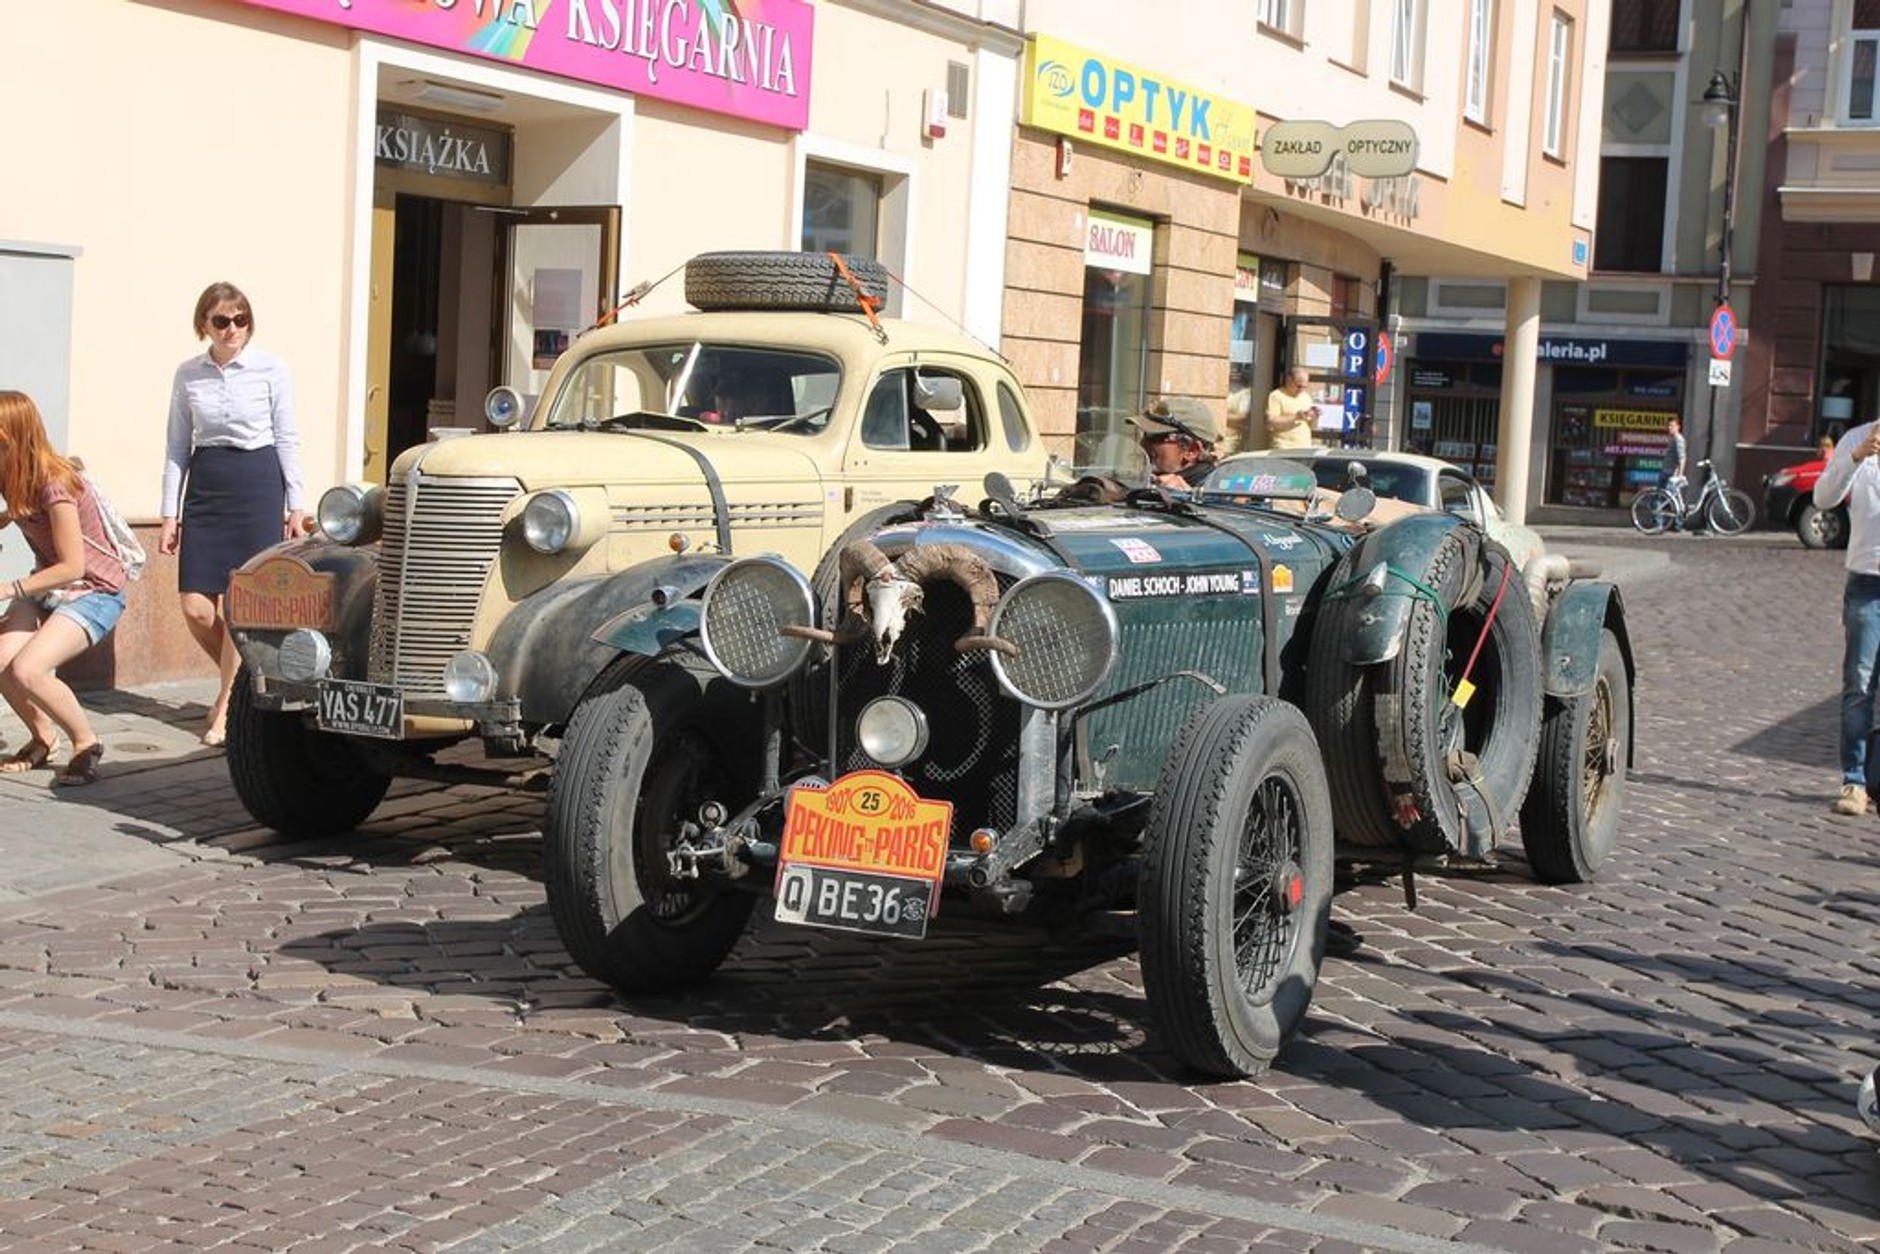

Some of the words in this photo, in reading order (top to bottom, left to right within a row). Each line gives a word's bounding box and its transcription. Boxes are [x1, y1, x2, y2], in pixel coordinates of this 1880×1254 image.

[567, 0, 798, 95] KSIĘGARNIA
[1081, 58, 1212, 141] OPTYK
[376, 125, 490, 174] KSIĄŻKA
[1274, 141, 1323, 155] ZAKŁAD
[1347, 139, 1412, 155] OPTYCZNY
[1089, 224, 1137, 259] SALON
[1346, 332, 1367, 449] OPTY
[1109, 578, 1142, 598] DANIEL
[1144, 576, 1180, 595] SCHOCH
[1185, 575, 1208, 594] JOHN
[1209, 574, 1239, 593] YOUNG
[323, 690, 359, 721] YAS
[364, 696, 399, 726] 477
[826, 788, 851, 814] 1907
[861, 792, 880, 811] 25
[889, 794, 916, 820] 2016
[787, 804, 866, 863] PEKING
[872, 818, 944, 871] PARIS
[783, 875, 805, 912] Q
[818, 879, 902, 925] BE36
